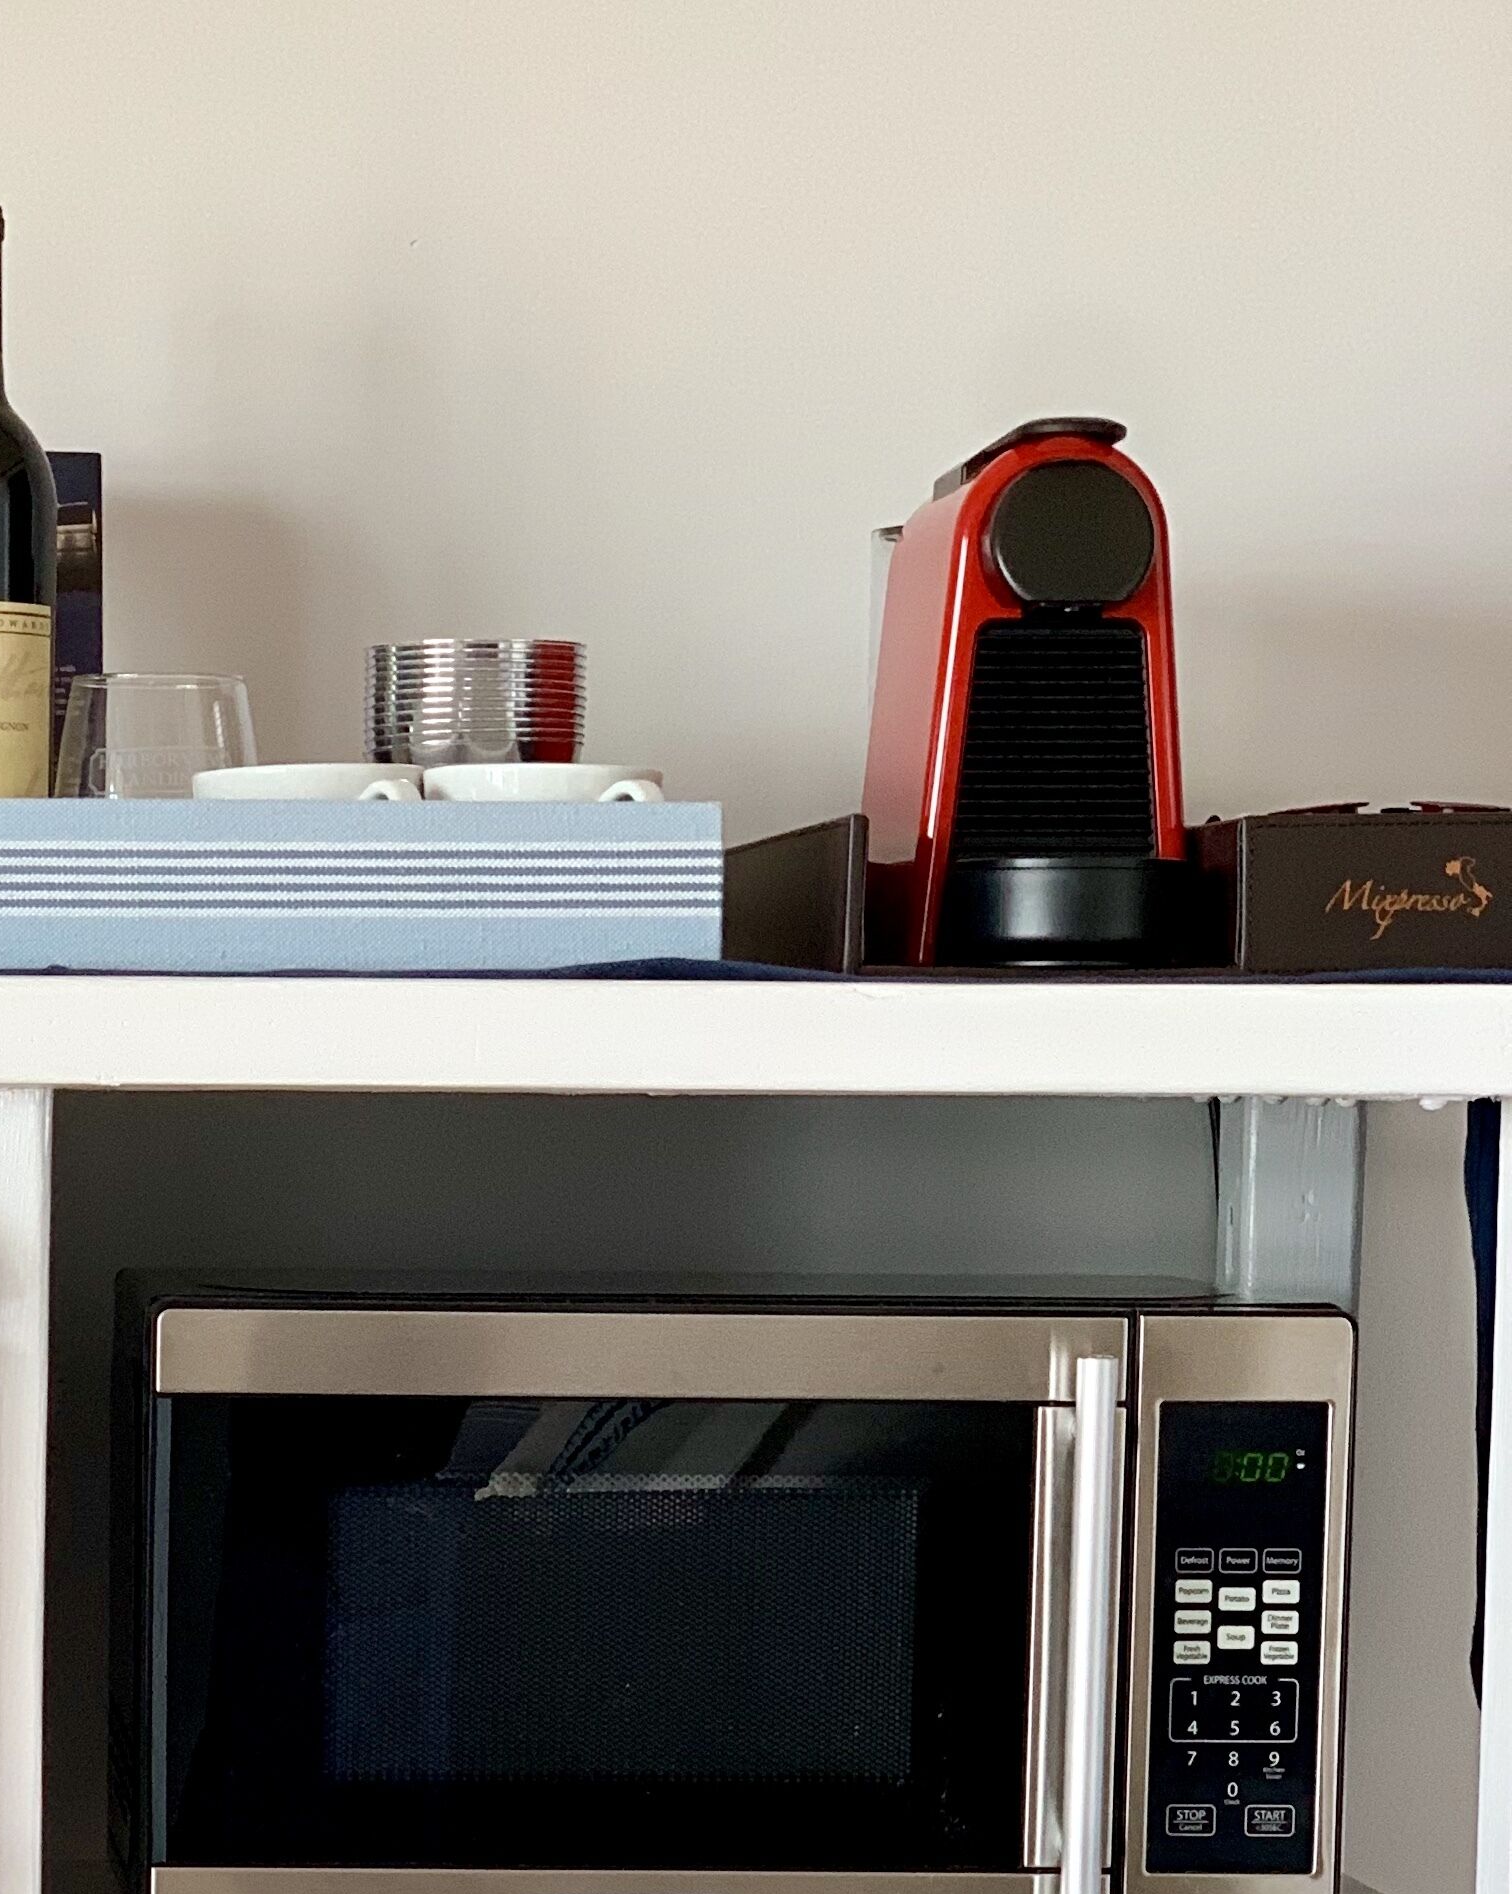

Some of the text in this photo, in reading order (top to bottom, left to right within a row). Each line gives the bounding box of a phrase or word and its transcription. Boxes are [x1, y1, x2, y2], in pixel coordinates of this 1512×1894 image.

[1226, 1555, 1251, 1565] Power
[1266, 1555, 1299, 1567] Memory
[1226, 1632, 1247, 1642] Soup
[1203, 1675, 1268, 1685] EXPRESS COOK
[1190, 1691, 1198, 1707] 1
[1230, 1691, 1241, 1707] 2
[1270, 1691, 1281, 1707] 3
[1187, 1720, 1198, 1735] 4
[1229, 1720, 1240, 1736] 5
[1269, 1720, 1281, 1736] 6
[1187, 1751, 1197, 1766] 7
[1228, 1751, 1239, 1767] 8
[1268, 1751, 1280, 1767] 9
[1227, 1782, 1238, 1797] 0
[1176, 1809, 1207, 1821] STOP
[1253, 1809, 1286, 1821] START
[1178, 1823, 1203, 1832] Cancel
